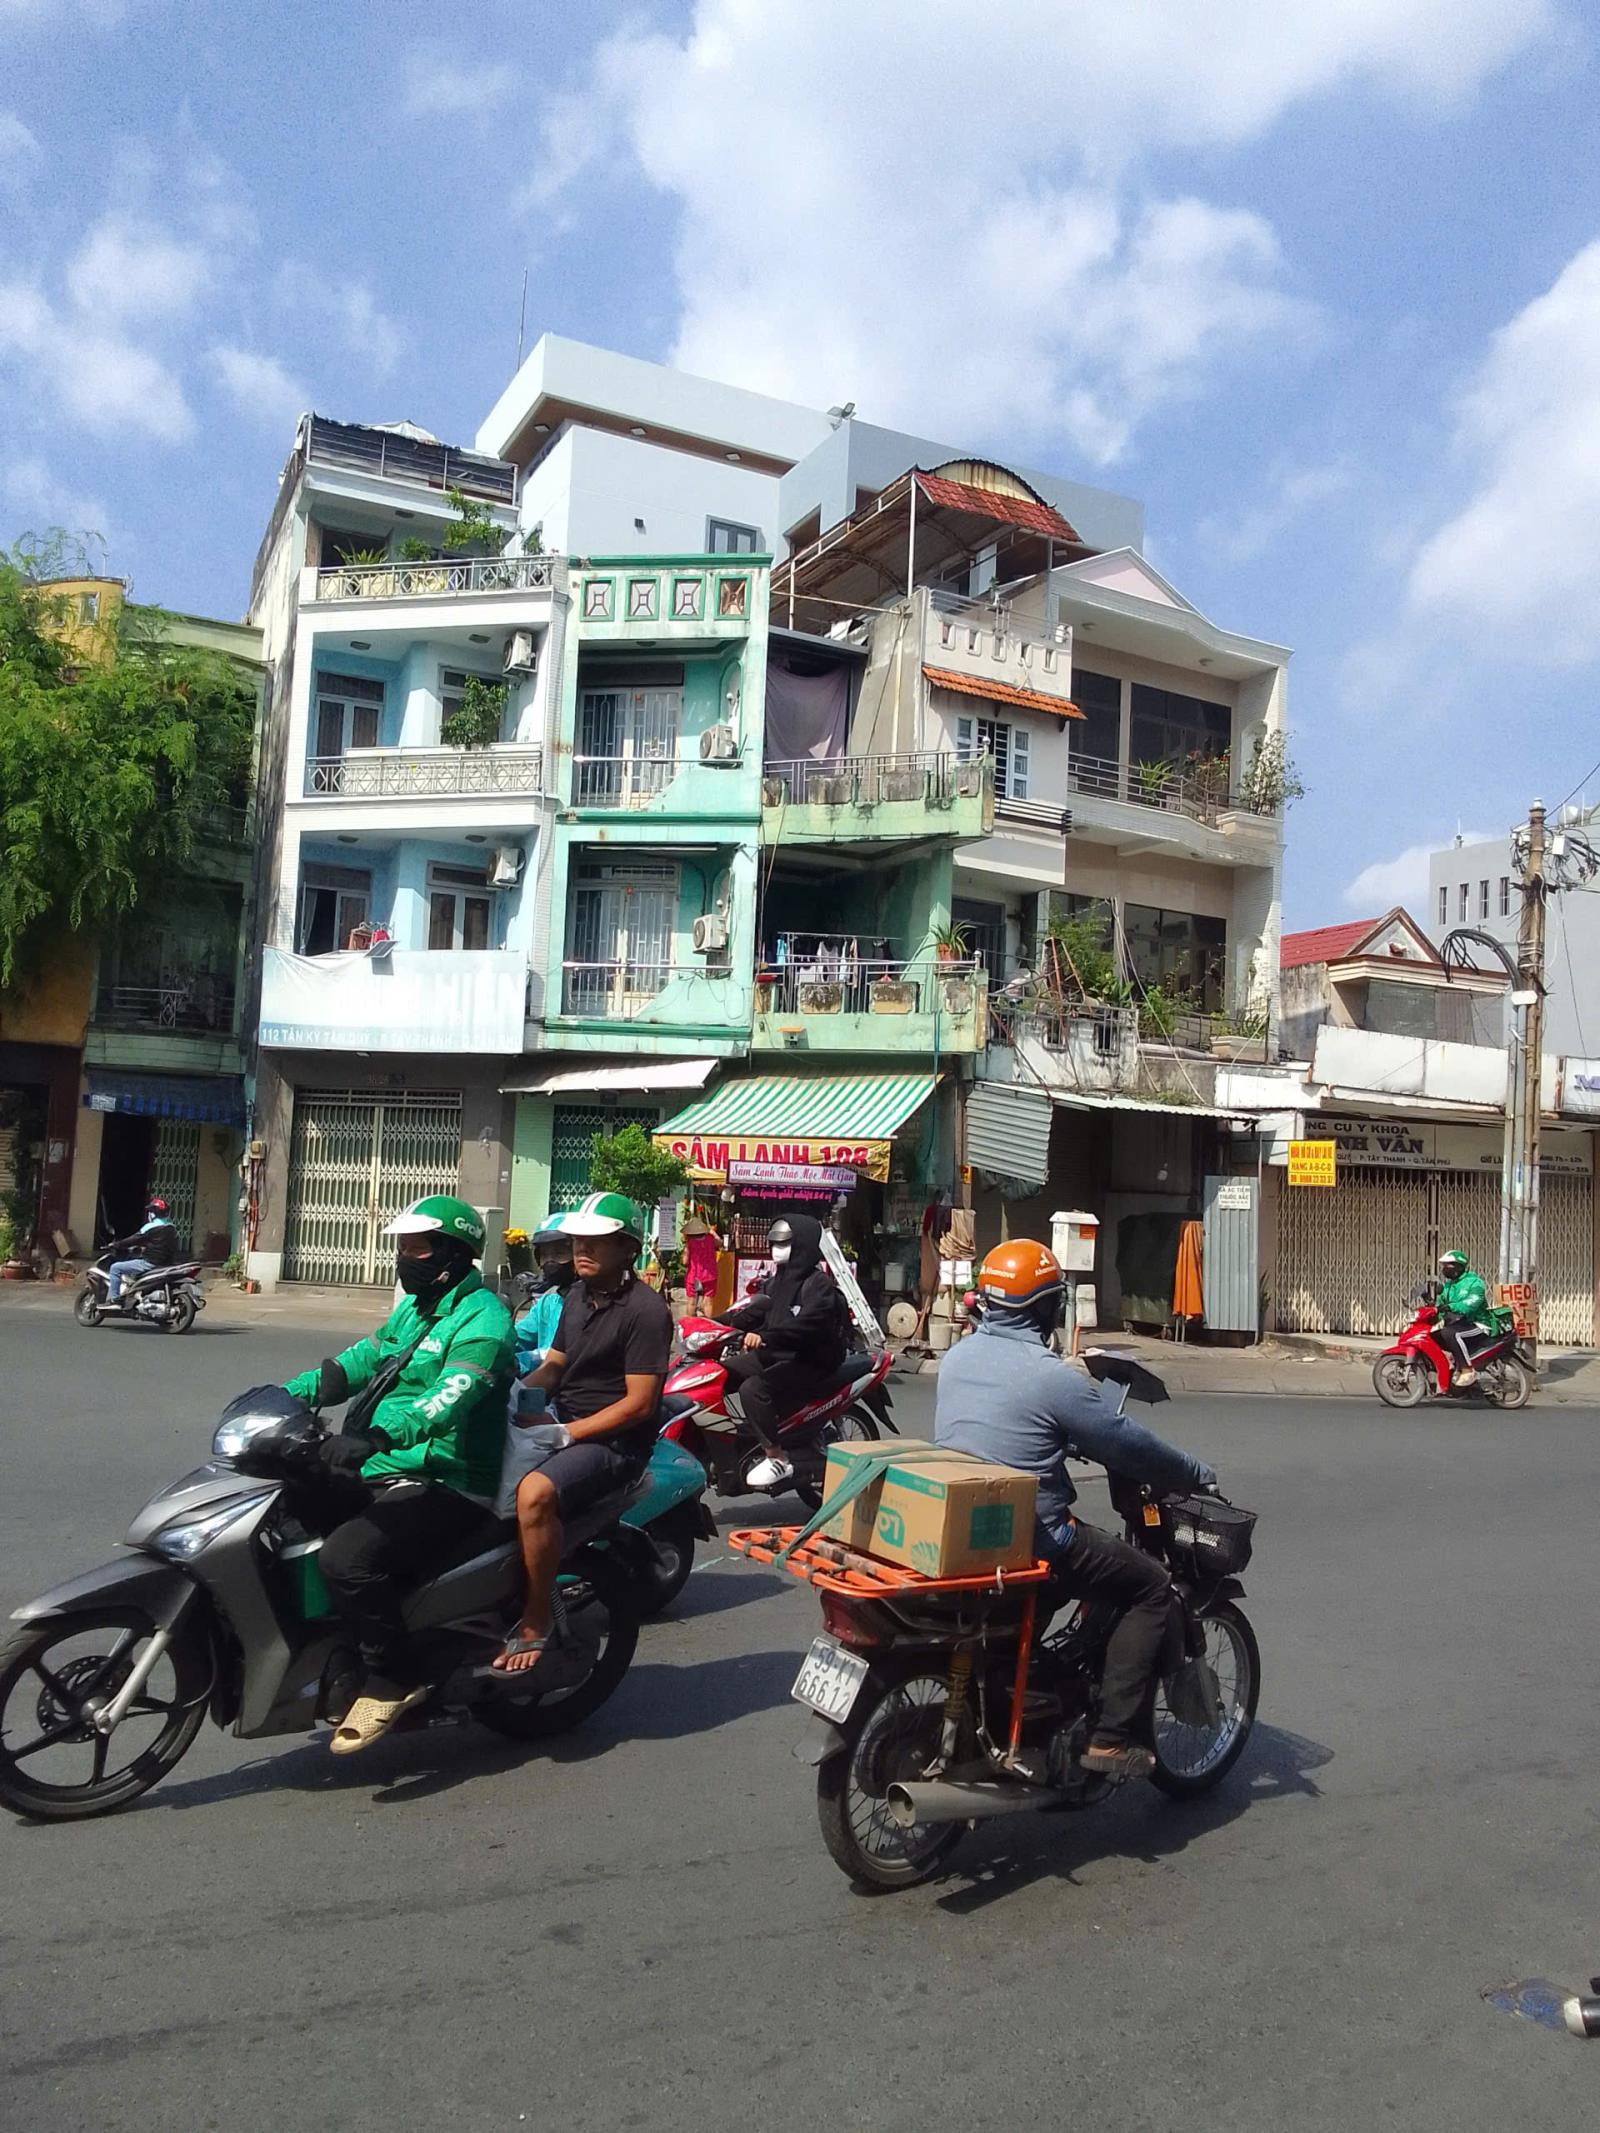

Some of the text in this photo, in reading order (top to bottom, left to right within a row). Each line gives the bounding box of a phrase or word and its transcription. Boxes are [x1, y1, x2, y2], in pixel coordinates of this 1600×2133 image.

[262, 1028, 280, 1041] 112
[1357, 1124, 1367, 1133] Y
[1371, 1124, 1410, 1135] KHOA
[1377, 1135, 1424, 1153] VÂN
[671, 1136, 729, 1170] SÂM
